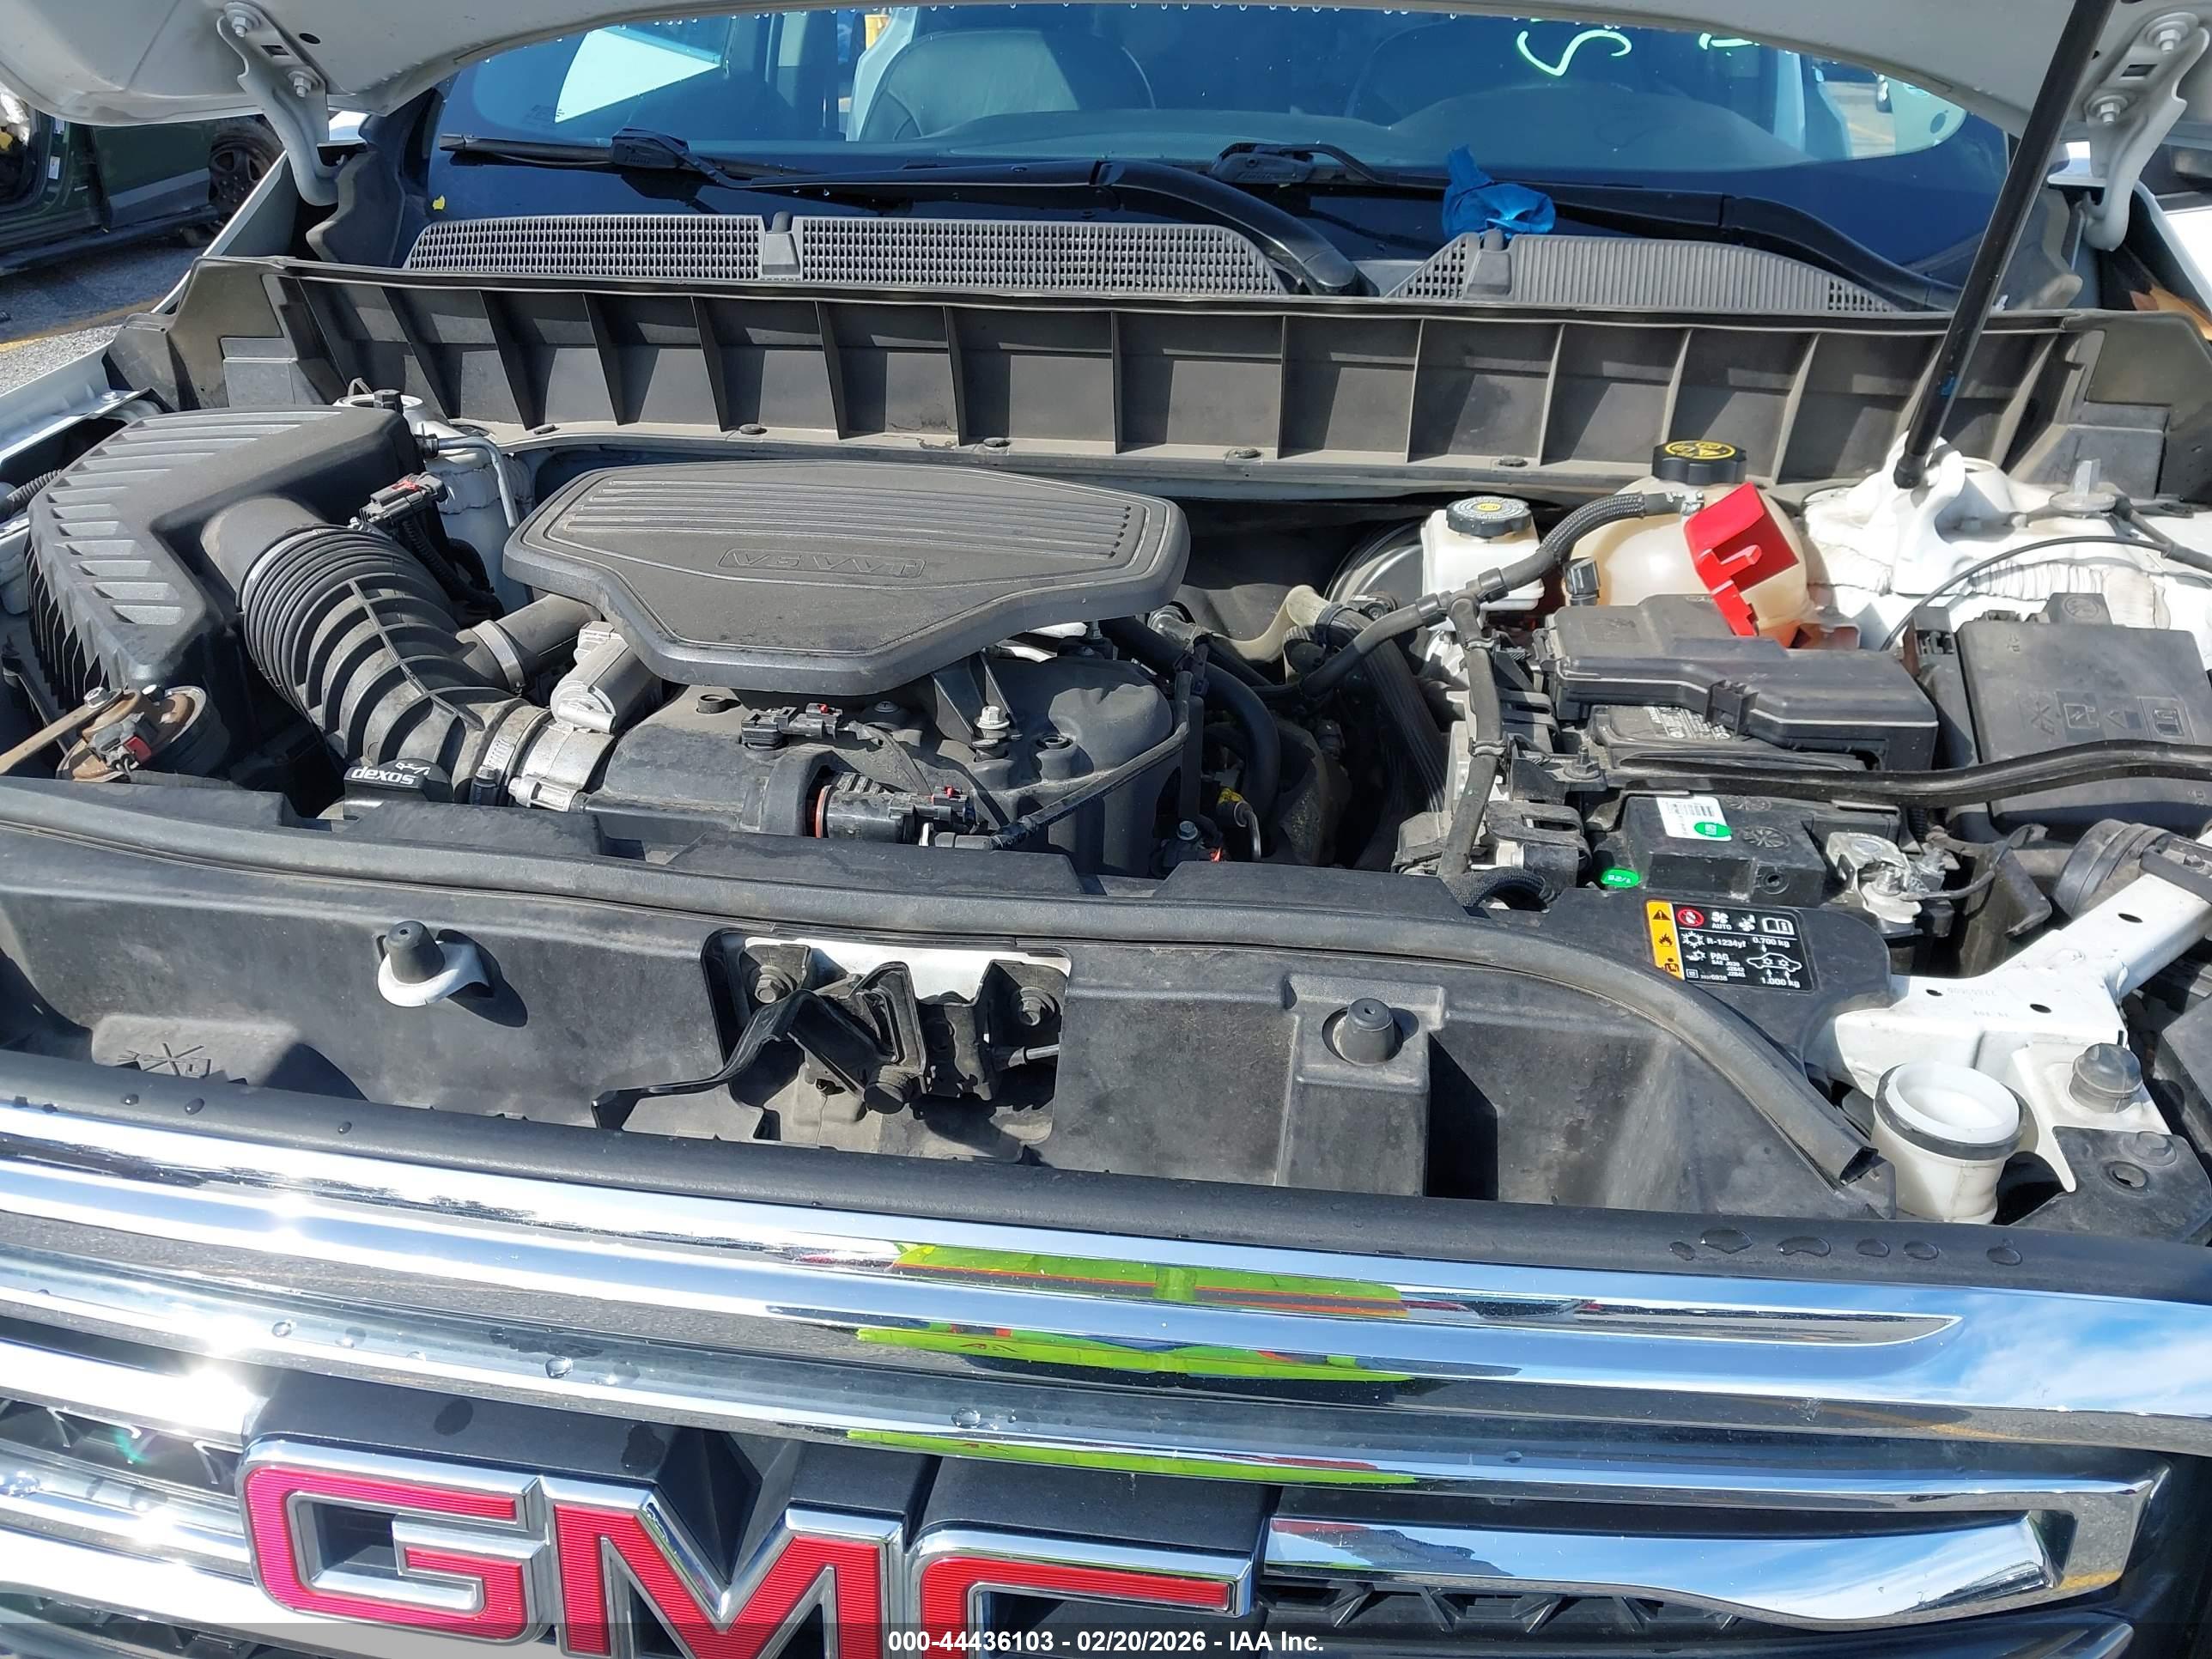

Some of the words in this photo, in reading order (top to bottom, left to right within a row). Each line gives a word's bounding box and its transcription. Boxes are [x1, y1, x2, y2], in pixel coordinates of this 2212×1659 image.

[350, 767, 417, 785] dexos
[1706, 938, 1747, 949] R-1234yf
[1753, 937, 1776, 946] 0.700
[1778, 939, 1790, 948] kg
[1710, 952, 1729, 962] PAG
[1761, 976, 1786, 987] 1.000
[1787, 979, 1801, 989] kg
[244, 1436, 1253, 1659] GMC
